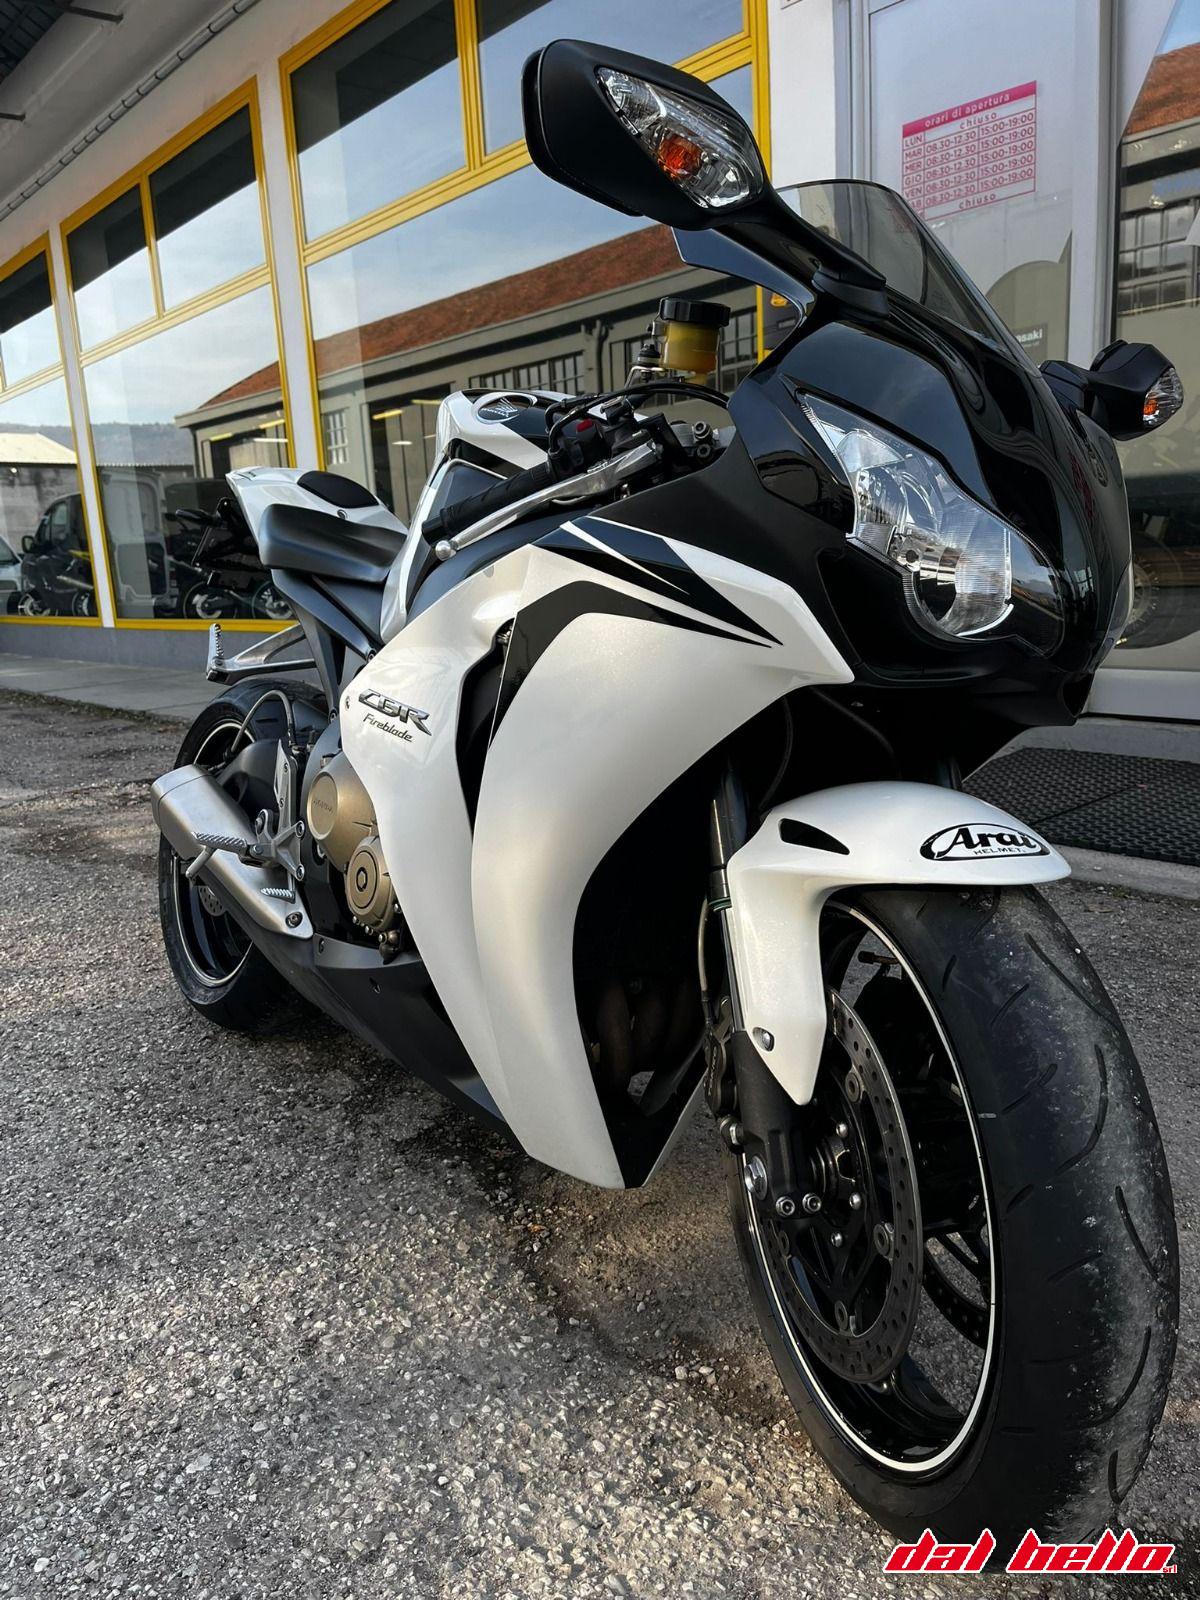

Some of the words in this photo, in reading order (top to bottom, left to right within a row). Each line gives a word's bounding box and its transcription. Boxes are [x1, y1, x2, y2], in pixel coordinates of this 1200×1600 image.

[924, 112, 949, 127] orari
[951, 106, 961, 119] di
[965, 94, 1010, 113] apertura
[904, 134, 922, 147] LUN
[959, 112, 997, 130] chiuso
[904, 174, 922, 186] GIO
[904, 186, 923, 199] VEN
[958, 193, 996, 210] chiuso
[358, 688, 432, 736] CBR
[362, 712, 414, 743] Fireblade
[935, 827, 1037, 858] Arai
